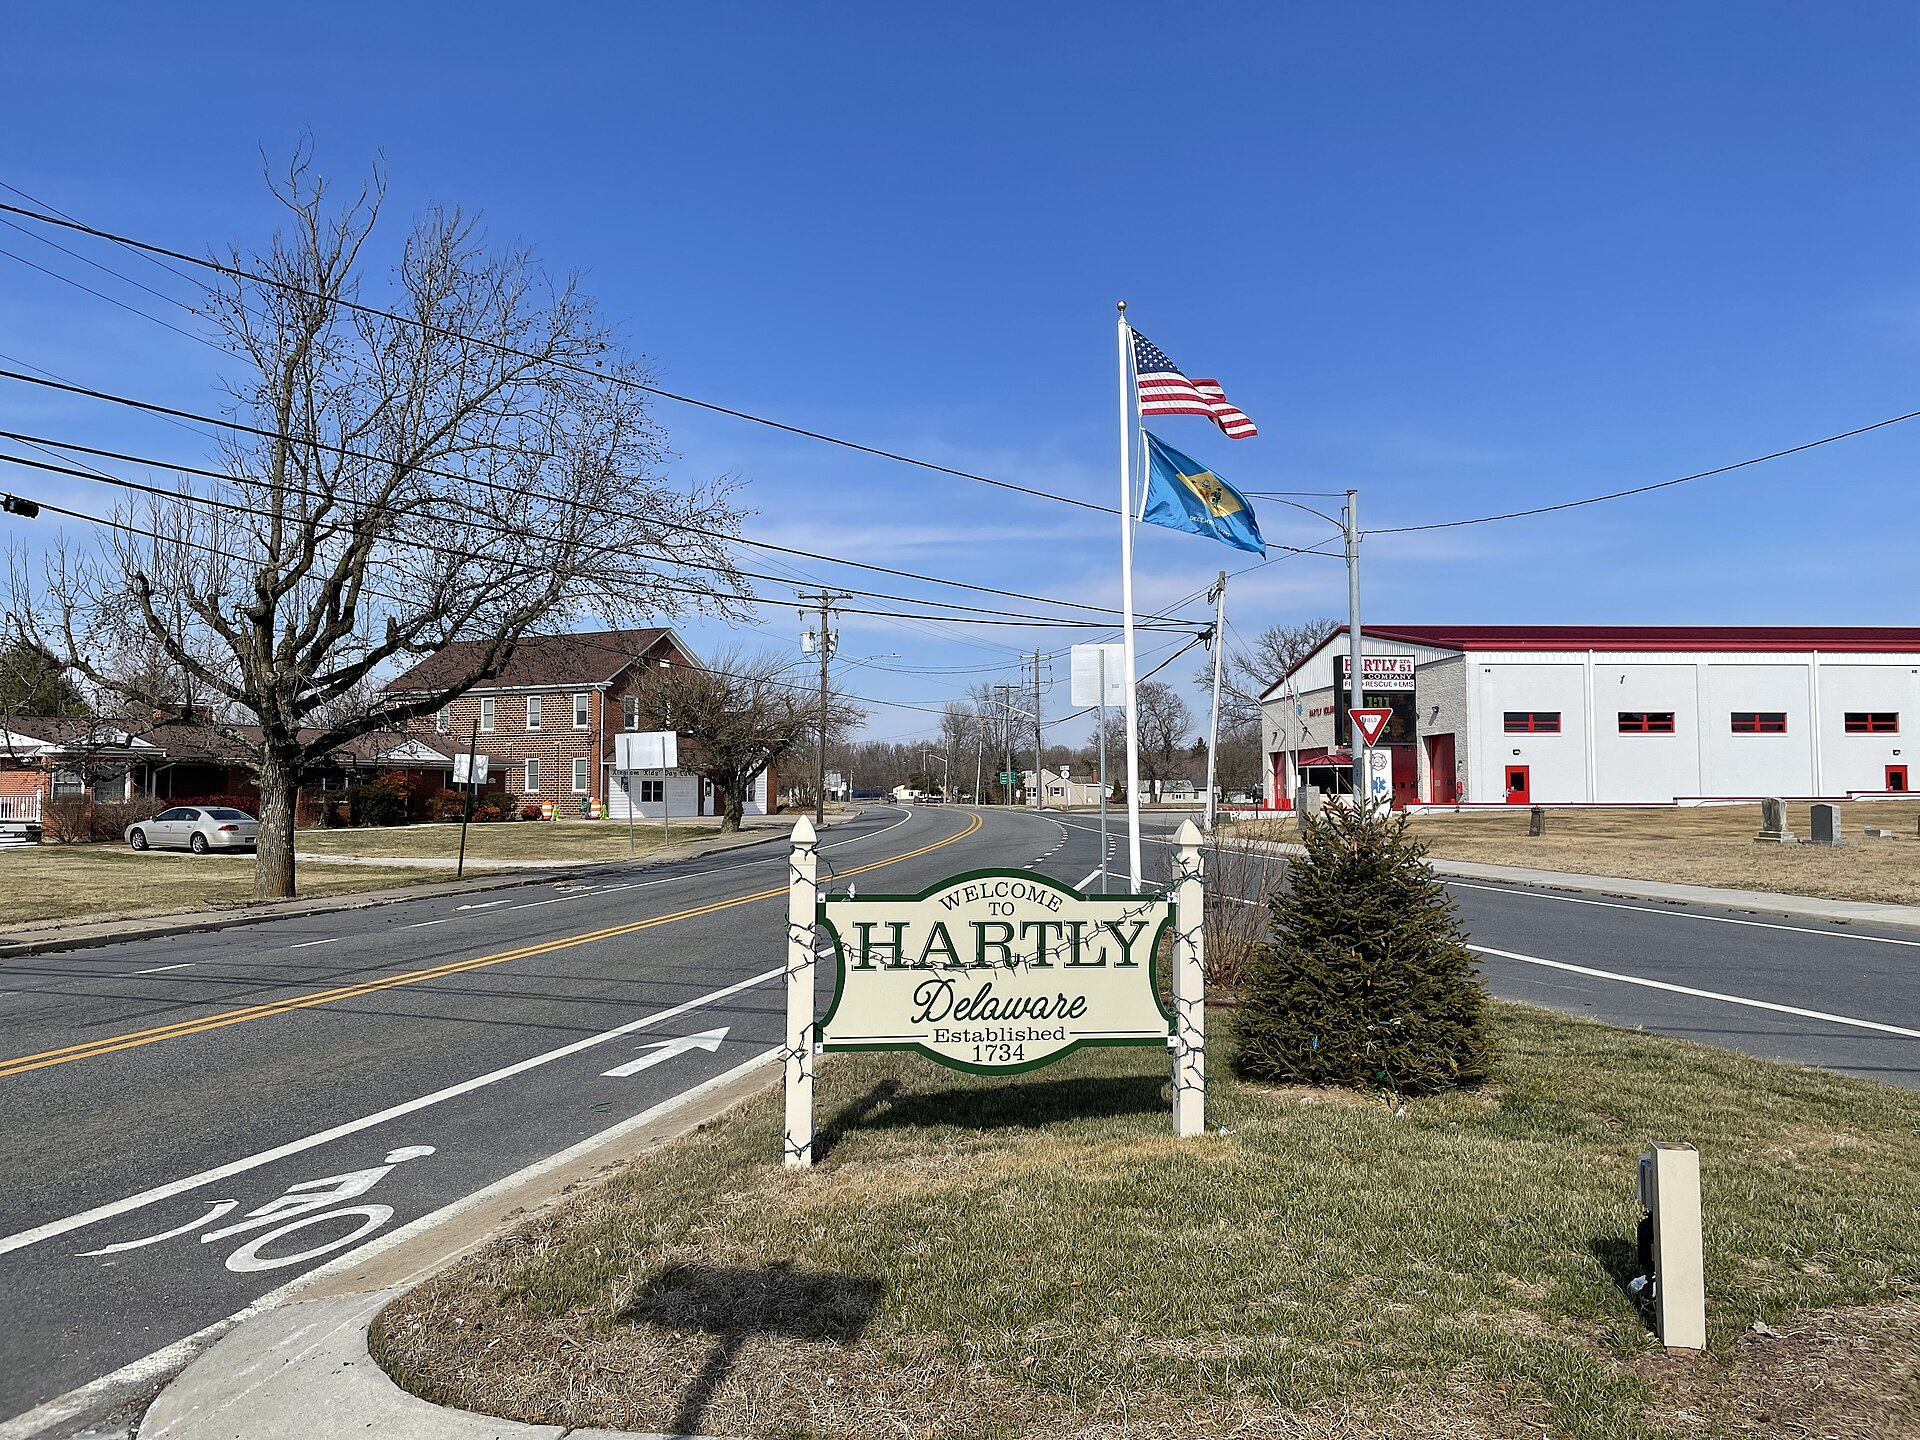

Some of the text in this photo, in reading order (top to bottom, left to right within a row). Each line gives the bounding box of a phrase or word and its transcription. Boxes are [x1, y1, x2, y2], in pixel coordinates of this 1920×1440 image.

[1344, 659, 1398, 671] HRTLY
[1399, 664, 1412, 672] 51
[939, 881, 1064, 913] WELCOME
[988, 901, 1015, 916] TO
[851, 919, 1150, 972] HARTLY
[910, 978, 1088, 1024] Delaware
[932, 1026, 1067, 1044] Established
[972, 1043, 1026, 1063] 1734
